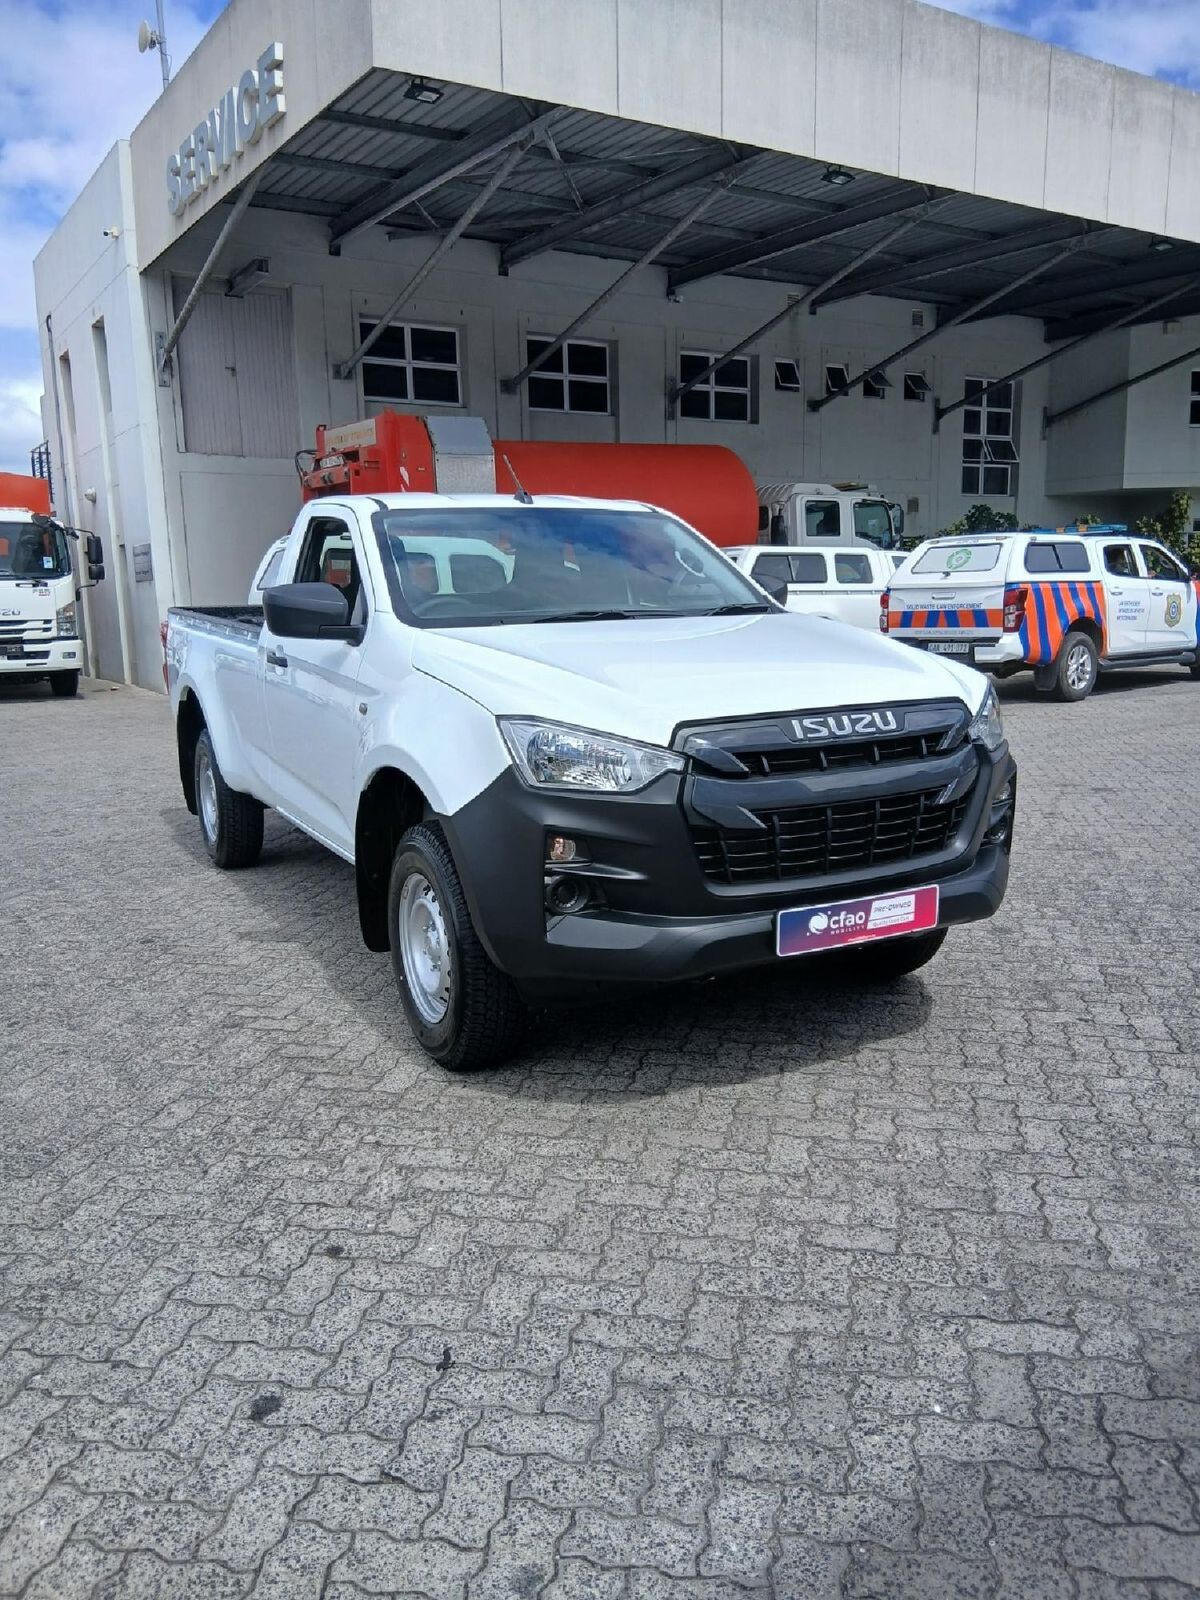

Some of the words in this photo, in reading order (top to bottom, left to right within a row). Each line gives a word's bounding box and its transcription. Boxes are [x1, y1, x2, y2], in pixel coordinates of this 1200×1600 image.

[167, 42, 287, 216] SERVICE
[791, 711, 897, 739] ISUZU
[830, 910, 866, 929] cfao
[830, 924, 866, 935] MOBILITY
